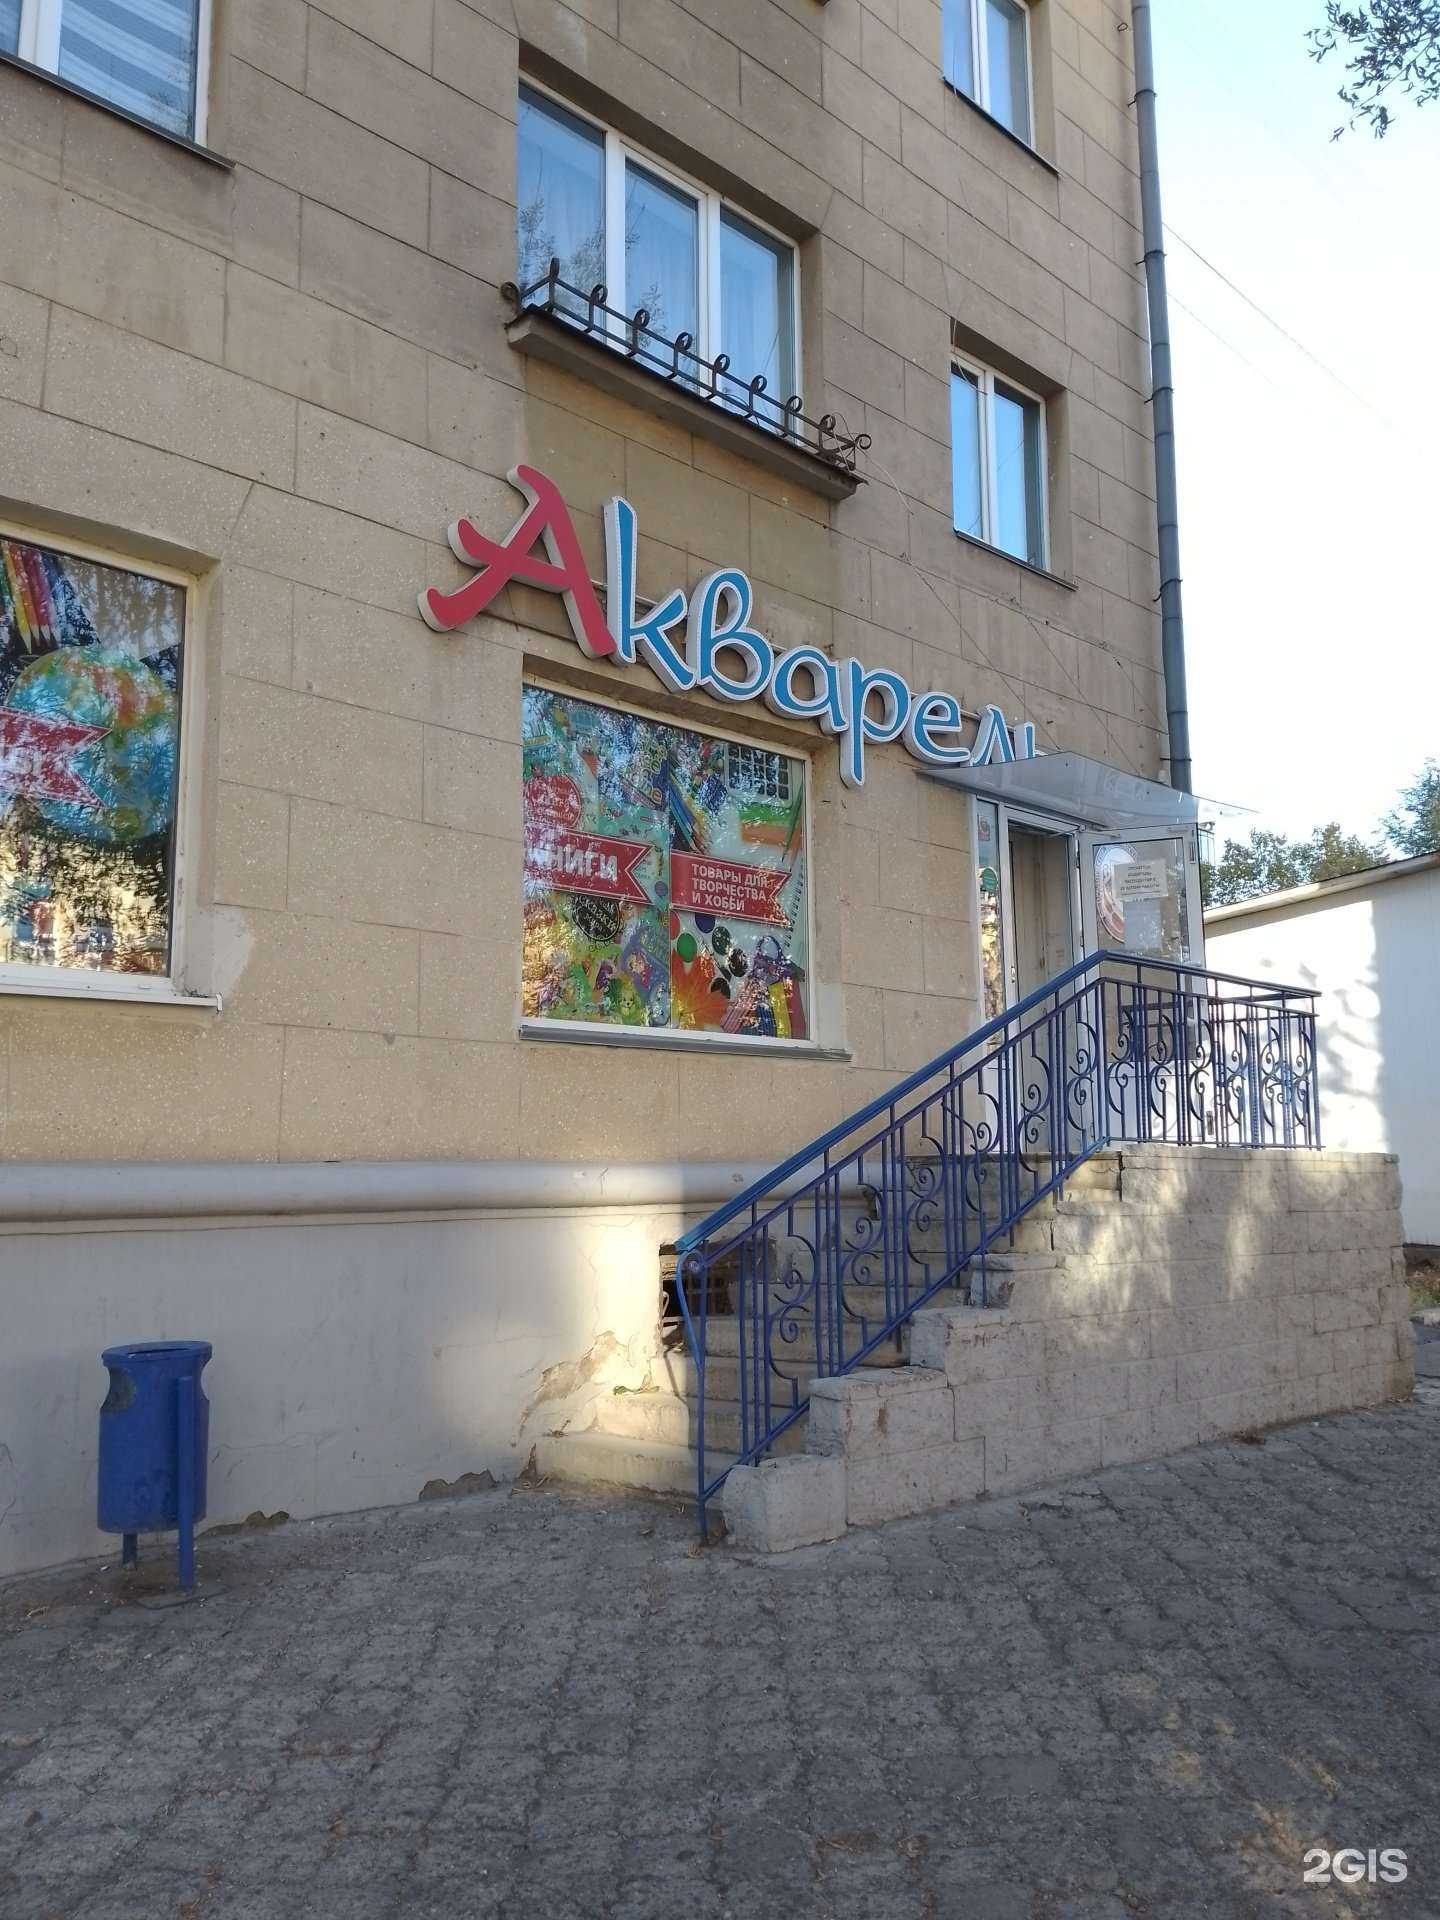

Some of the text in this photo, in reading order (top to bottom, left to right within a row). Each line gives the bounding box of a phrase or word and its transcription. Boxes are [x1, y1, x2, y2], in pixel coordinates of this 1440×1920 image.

[692, 863, 742, 884] ТОВАРЫ
[692, 877, 768, 902] ТВОРЧЕСТВА
[692, 890, 745, 912] И ХОББИ
